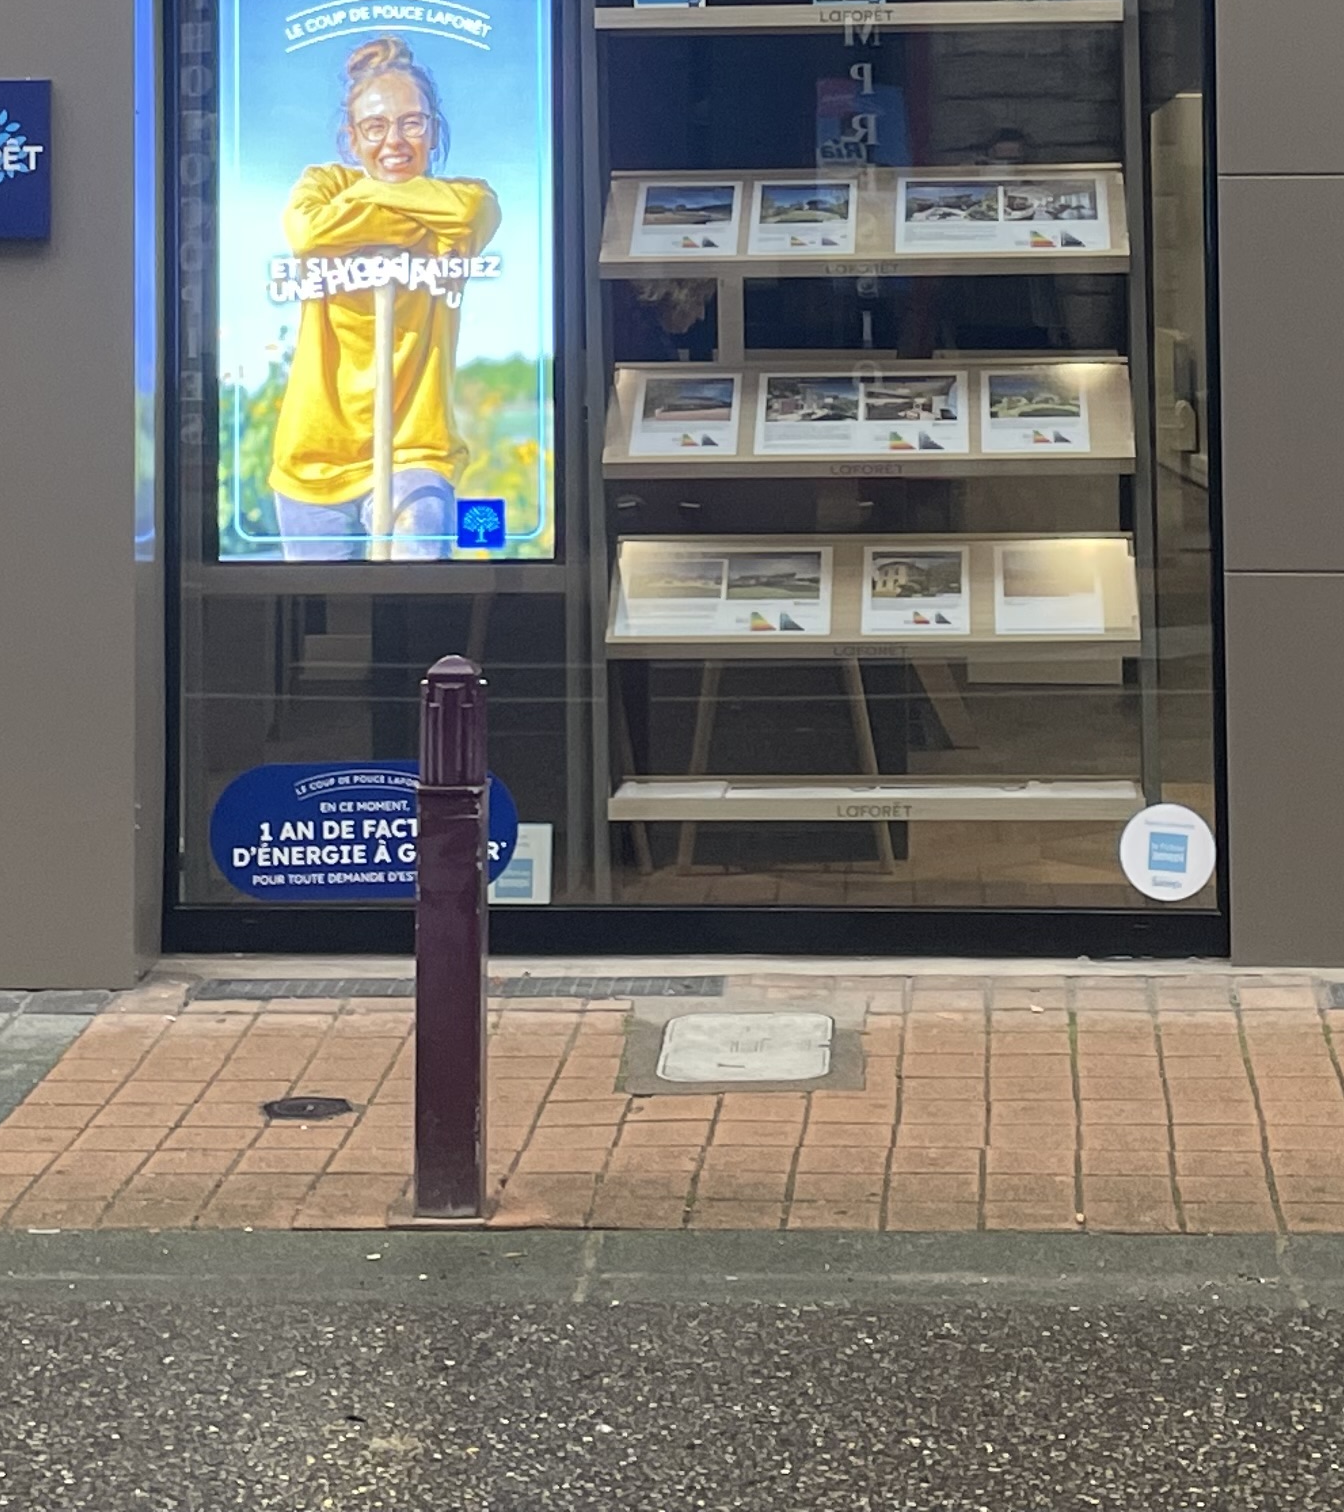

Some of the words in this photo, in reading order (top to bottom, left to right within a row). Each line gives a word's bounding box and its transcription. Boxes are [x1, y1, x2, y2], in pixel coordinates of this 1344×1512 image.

[285, 23, 305, 41] LE
[306, 10, 347, 34] COUP
[349, 7, 371, 22] DE
[372, 4, 425, 22] POUCE
[271, 257, 298, 279] ET
[319, 801, 336, 814] EN
[338, 801, 355, 813] CE
[260, 822, 273, 841] 1
[279, 820, 315, 841] AN
[321, 819, 355, 840] DE
[362, 817, 418, 839] FACT
[232, 842, 367, 868] D'ÉNERGIE
[373, 839, 392, 864] À
[252, 873, 286, 886] POUR
[287, 872, 325, 885] TOUTE
[327, 870, 385, 885] DEMANDE
